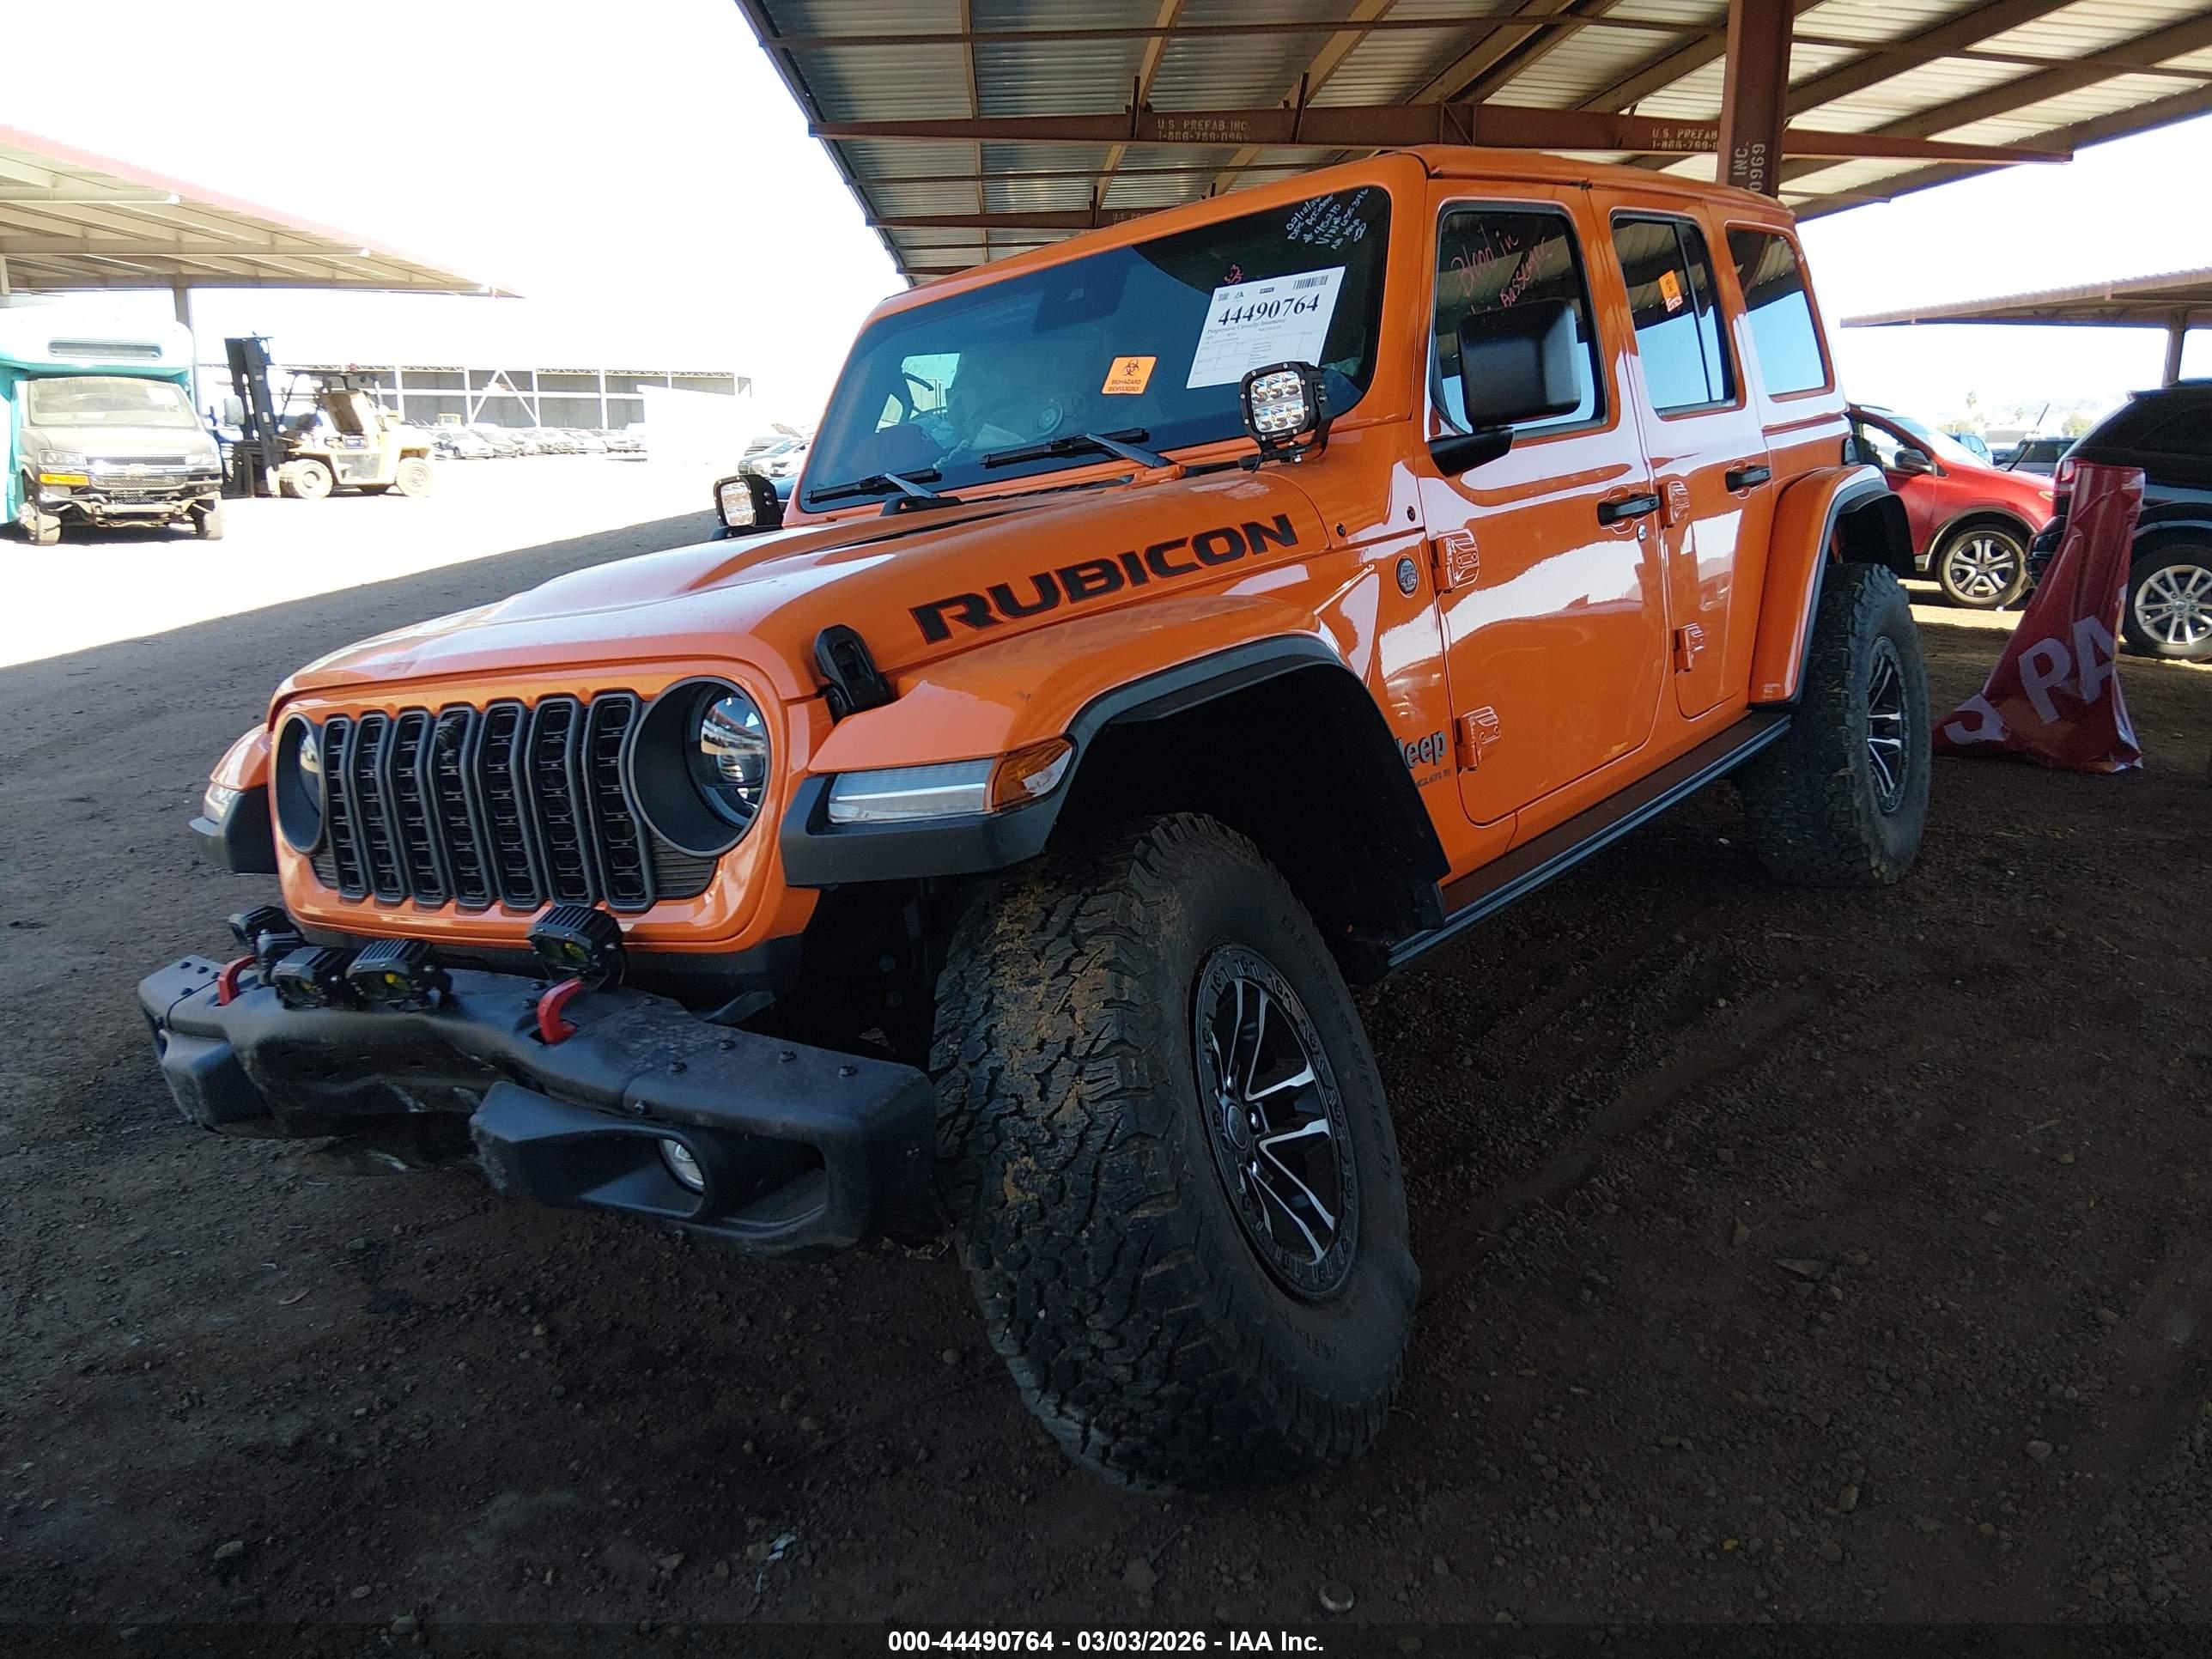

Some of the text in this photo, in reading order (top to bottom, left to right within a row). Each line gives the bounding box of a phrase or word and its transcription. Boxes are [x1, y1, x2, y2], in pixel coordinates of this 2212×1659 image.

[1183, 119, 1226, 131] PREFAB
[1677, 129, 1717, 140] PREFAB
[1734, 142, 1749, 176] INC.
[1749, 143, 1766, 191] 0969
[1218, 293, 1320, 325] 44490764
[908, 514, 1299, 646] RUBICON
